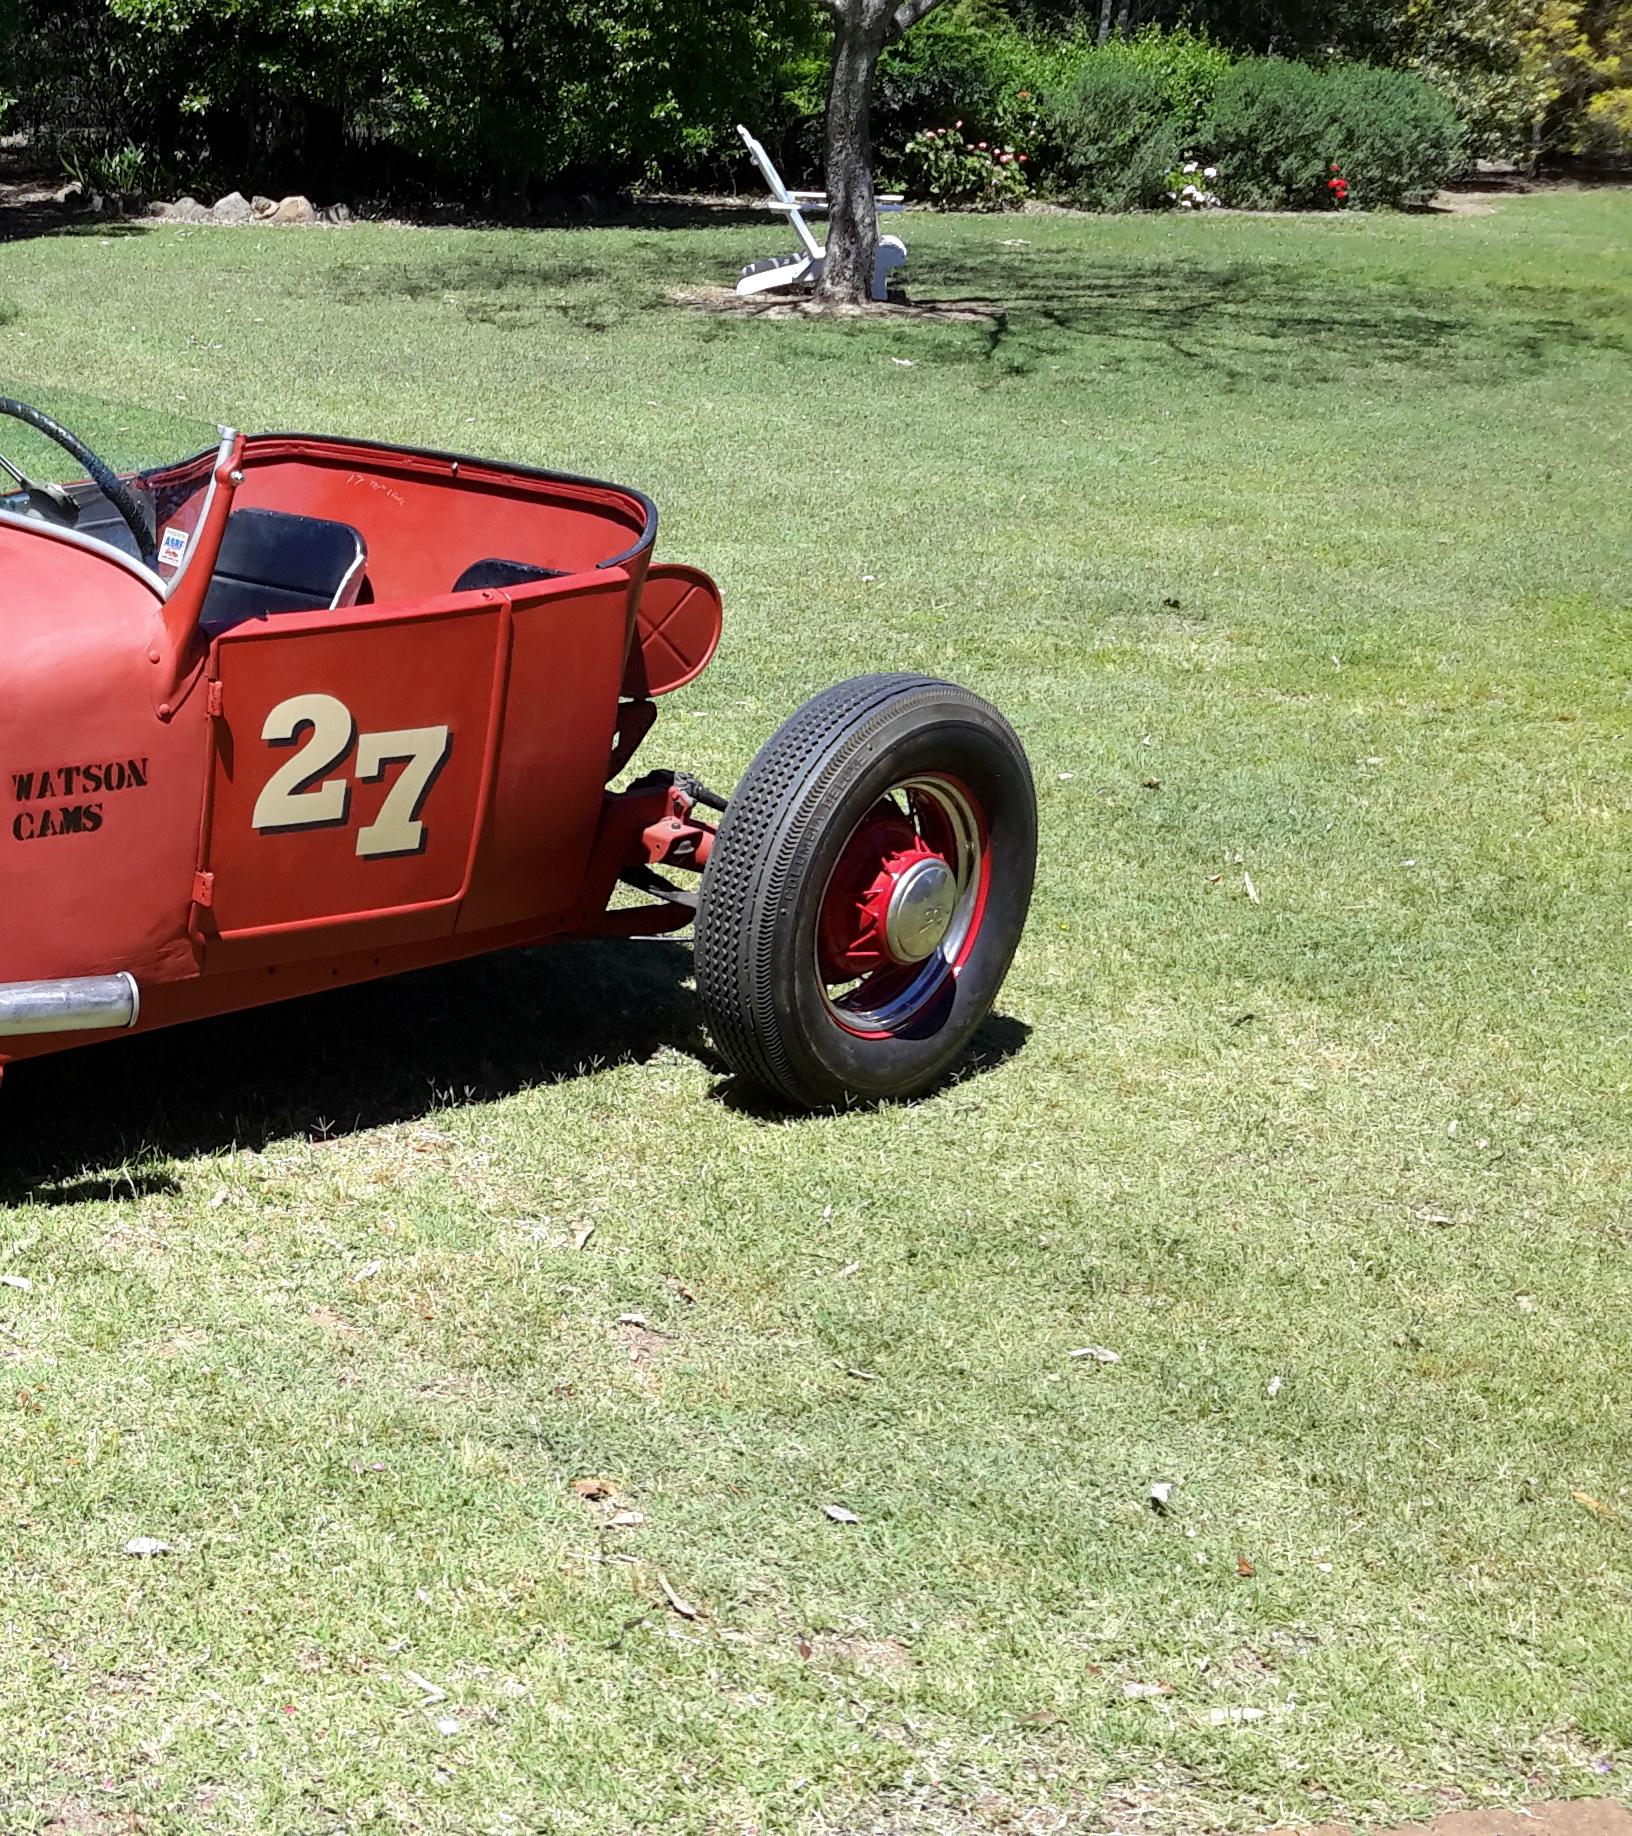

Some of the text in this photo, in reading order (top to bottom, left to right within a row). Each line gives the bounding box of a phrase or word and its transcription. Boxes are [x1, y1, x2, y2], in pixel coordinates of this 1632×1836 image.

[11, 757, 149, 802] WATSON
[251, 692, 455, 861] 27
[11, 803, 104, 842] CAMS
[784, 814, 826, 903] COLUMBIA
